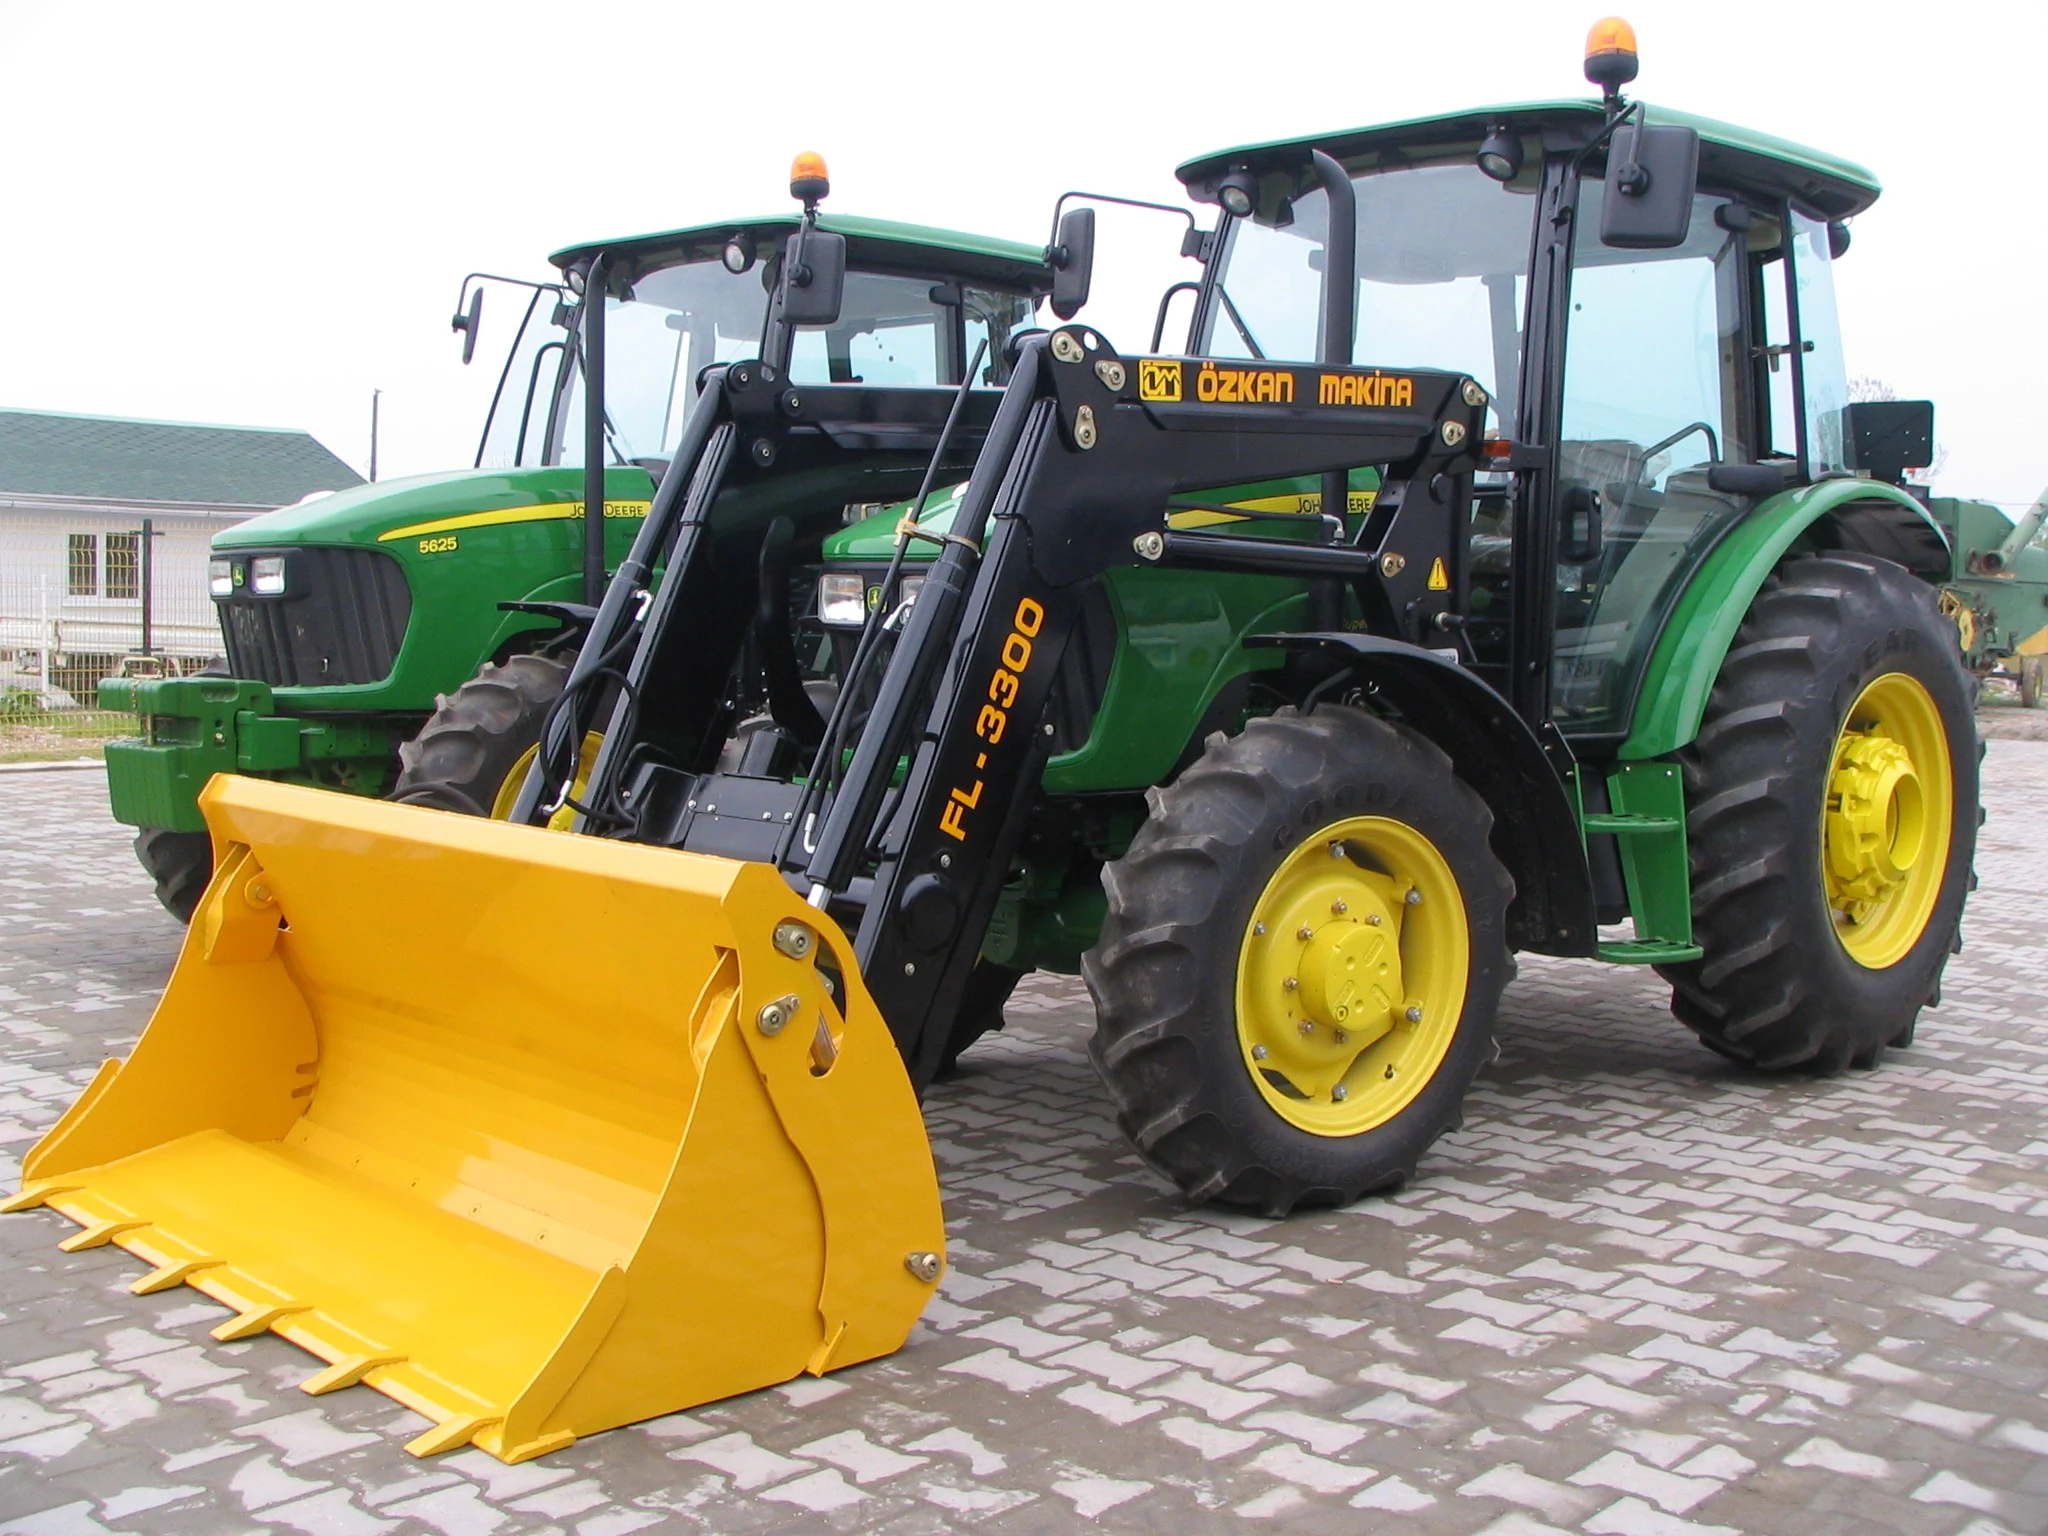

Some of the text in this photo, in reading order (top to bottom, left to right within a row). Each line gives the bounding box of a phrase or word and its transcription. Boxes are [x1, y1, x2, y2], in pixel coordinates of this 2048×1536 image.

[1197, 362, 1294, 403] ÖZKAN
[604, 503, 643, 516] DEERE
[1296, 497, 1371, 514] JOH ERE
[419, 536, 458, 554] 5625
